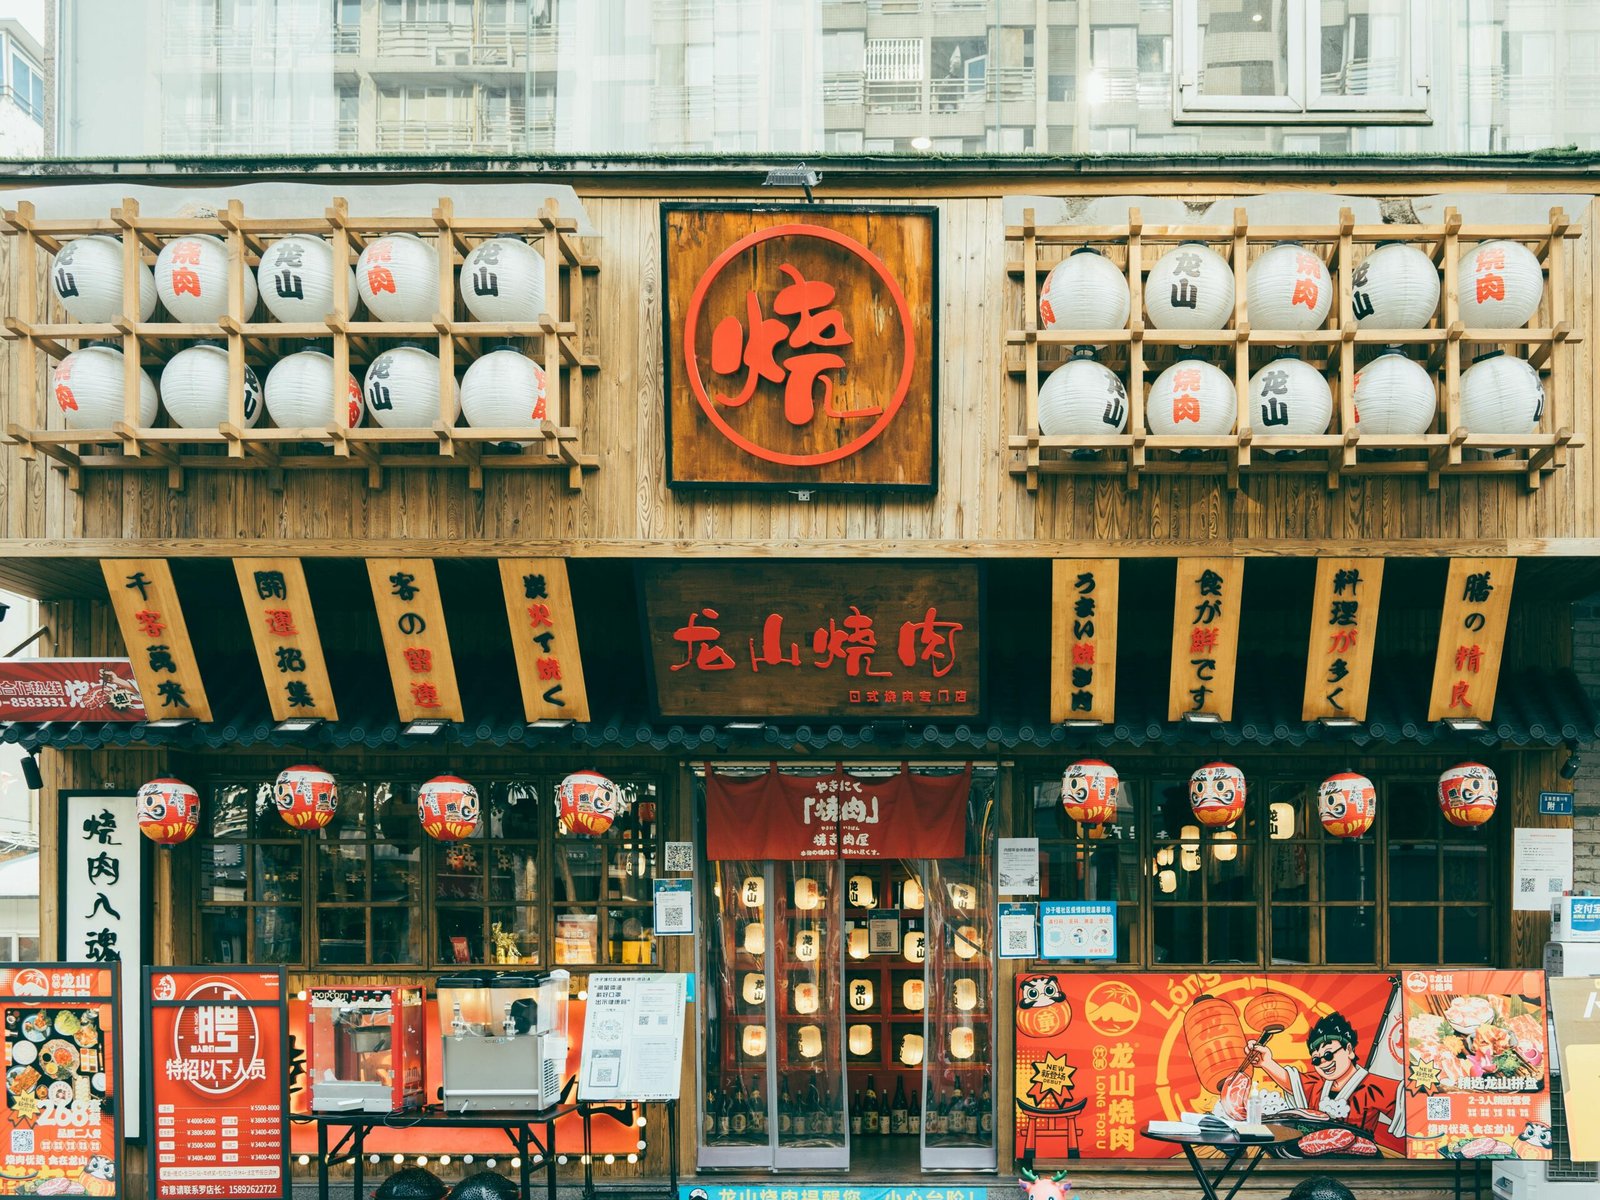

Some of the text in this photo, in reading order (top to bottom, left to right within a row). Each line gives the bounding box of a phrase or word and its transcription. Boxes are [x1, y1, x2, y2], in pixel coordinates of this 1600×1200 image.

[54, 243, 80, 299] 龙山
[172, 241, 201, 298] 烧肉
[274, 244, 304, 301] 龙山
[366, 239, 397, 296] 烧肉
[472, 243, 502, 298] 龙山
[1170, 252, 1202, 310] 龙山
[1291, 252, 1322, 310] 烧肉
[1475, 247, 1506, 303] 烧肉
[711, 262, 883, 425] 烧
[54, 353, 79, 412] 烧肉
[369, 354, 393, 411] 龙山
[1103, 369, 1126, 428] 龙山
[1172, 368, 1202, 424] 烧肉
[1260, 369, 1290, 427] 龙山
[670, 605, 964, 678] 龙山烧肉
[1071, 572, 1096, 712] うまい焼き肉
[1189, 569, 1224, 711] 食が鮮です
[1326, 569, 1364, 710] 料理が多く
[0, 680, 64, 696] 合作热线
[0, 697, 67, 708] -8583331
[849, 689, 968, 703] 日式烧肉专门店
[816, 779, 863, 794] やきにく
[747, 881, 758, 903] 龙山
[802, 934, 813, 956] 龙山
[61, 973, 91, 989] 龙山
[855, 984, 866, 1006] 龙山
[165, 1058, 266, 1080] 特招以下人员
[1041, 1069, 1066, 1081] 新登场
[1045, 1063, 1065, 1072] NEW
[1096, 1076, 1106, 1108] LONG
[1457, 1076, 1539, 1090] 精选龙山拼盘
[37, 1099, 89, 1127] 268
[1109, 1042, 1136, 1152] 龙山烧肉
[1096, 1113, 1106, 1137] FOR
[1096, 1140, 1106, 1149] U
[228, 1185, 277, 1195] 15892622722
